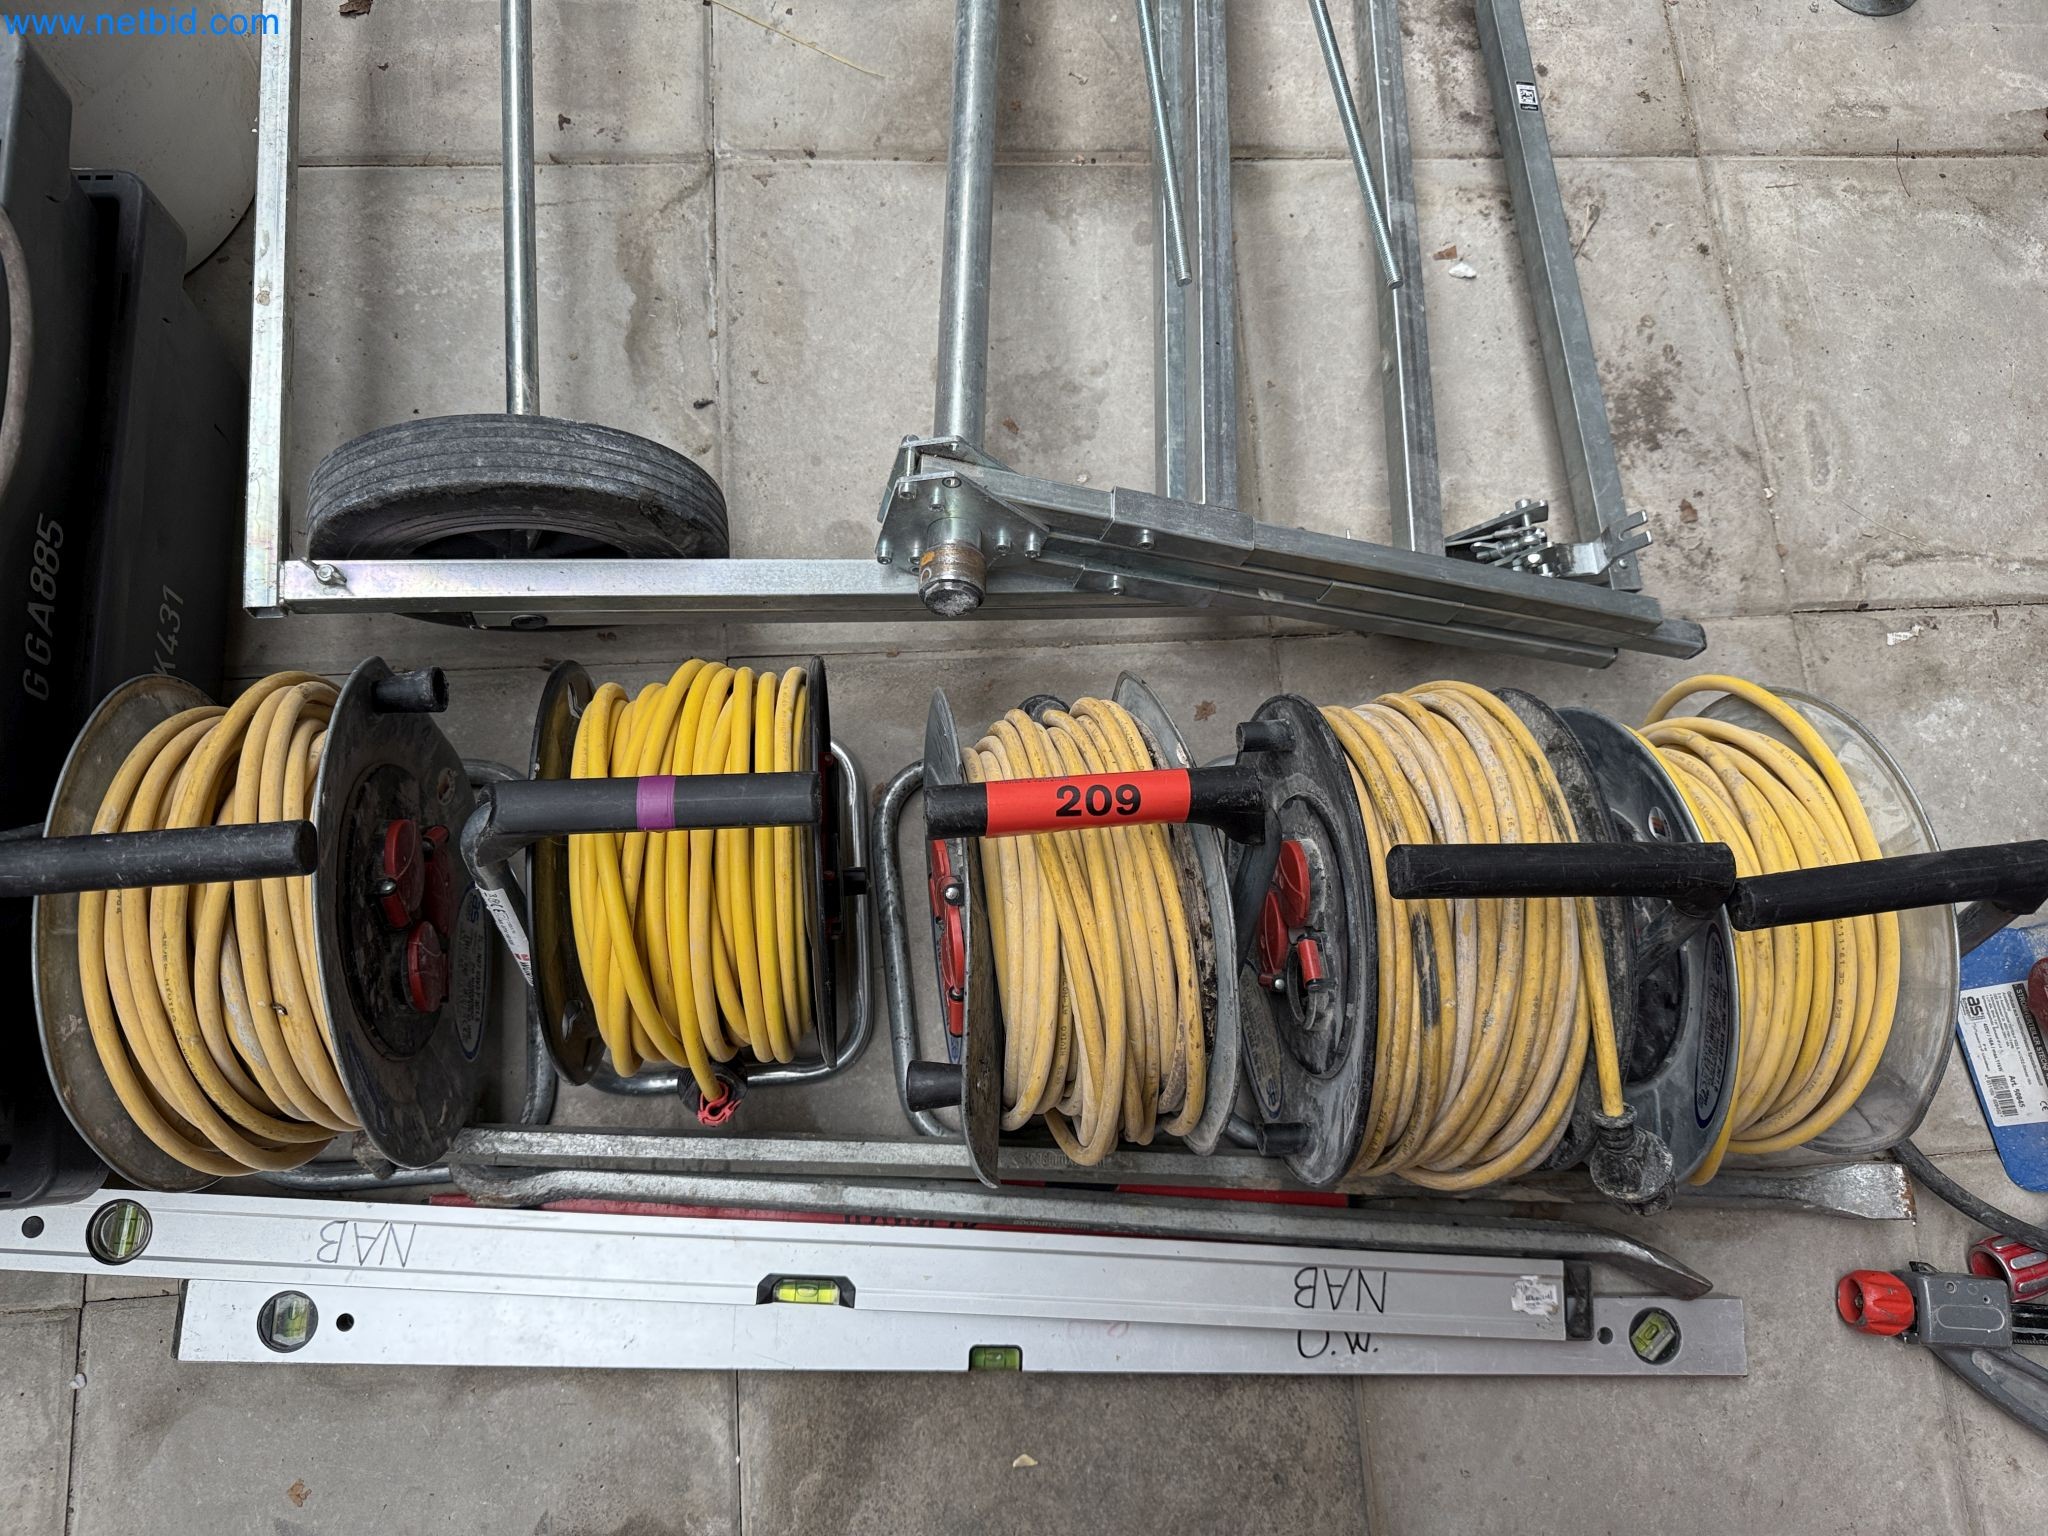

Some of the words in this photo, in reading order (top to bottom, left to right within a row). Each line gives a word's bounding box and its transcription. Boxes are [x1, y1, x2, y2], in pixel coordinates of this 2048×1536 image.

[1055, 783, 1142, 817] 209
[2008, 1074, 2018, 1086] Art.
[316, 1219, 416, 1268] NAB
[1294, 1267, 1387, 1313] NAB
